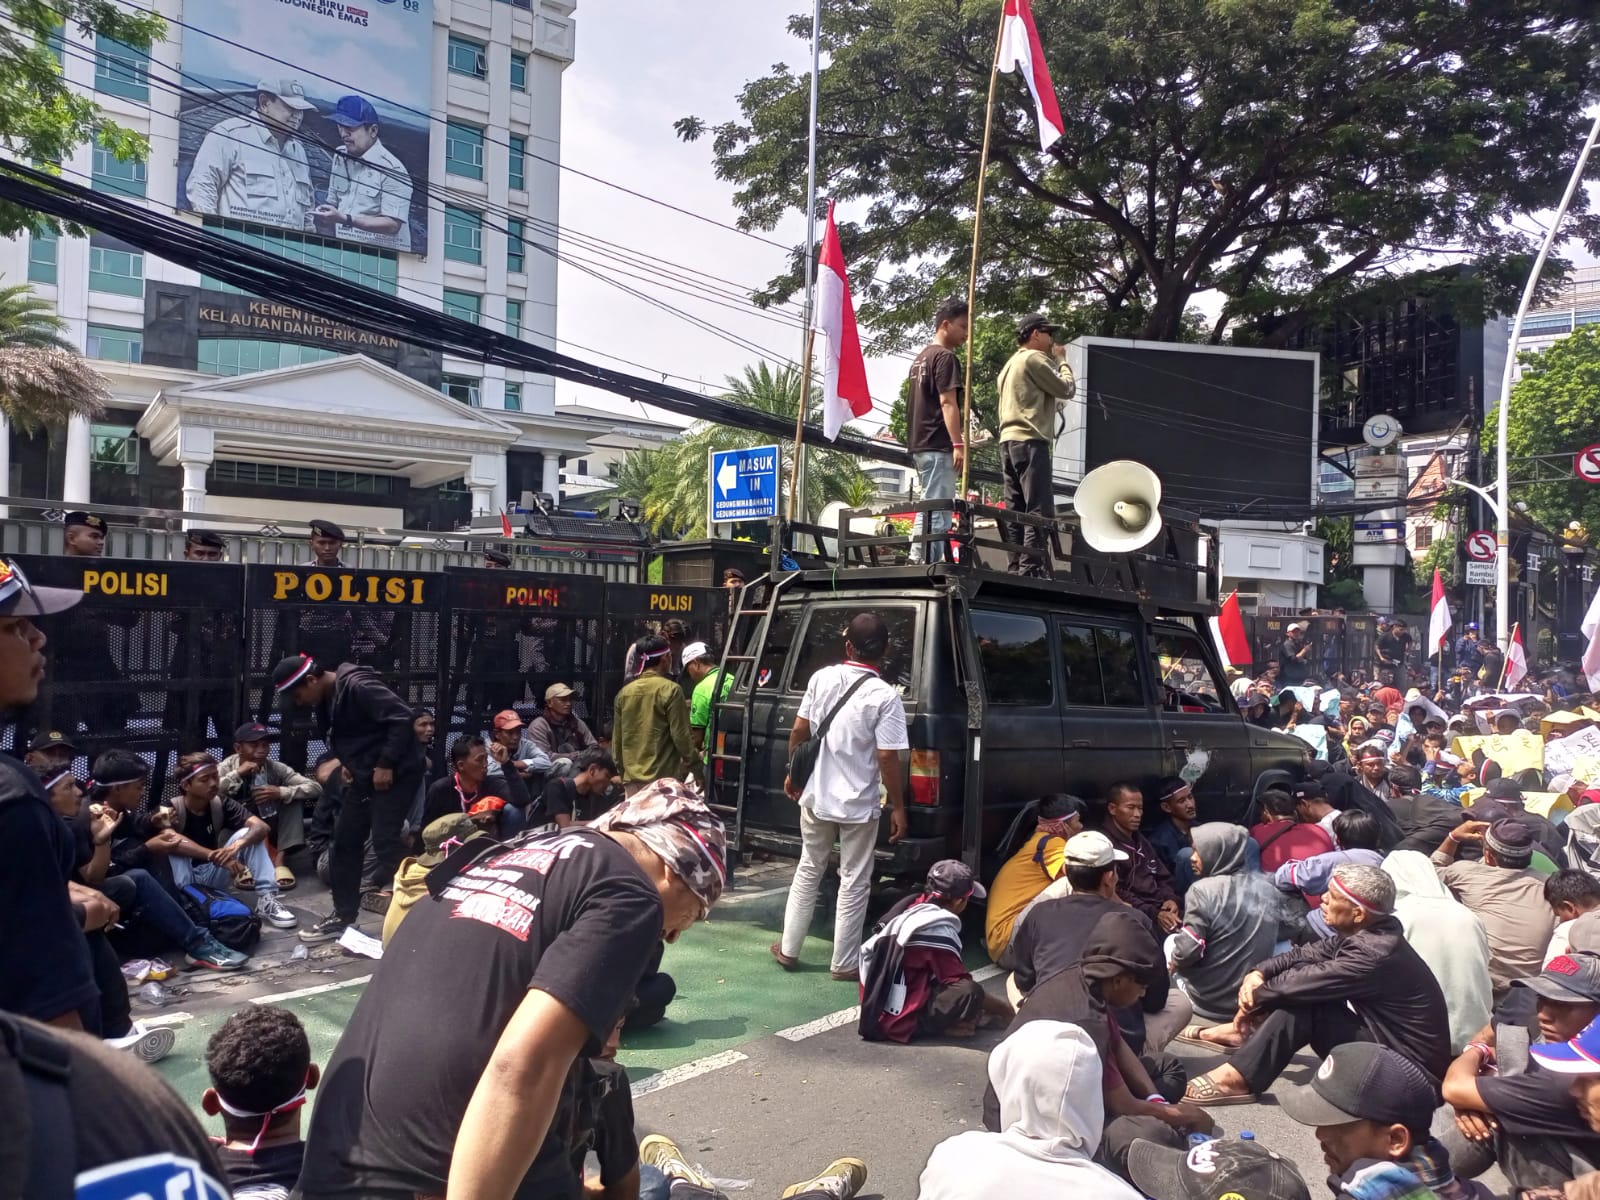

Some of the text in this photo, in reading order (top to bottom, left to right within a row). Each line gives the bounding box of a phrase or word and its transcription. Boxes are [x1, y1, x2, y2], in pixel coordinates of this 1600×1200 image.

[337, 12, 369, 27] EMAS
[249, 301, 356, 329] KEMENTER
[199, 307, 399, 348] KELAUTAN DAN PERIKANAN
[739, 455, 773, 472] MASUK
[750, 477, 760, 491] IN
[83, 571, 167, 596] POLISI
[273, 572, 425, 604] POLISI
[506, 587, 558, 606] POLISI
[650, 594, 692, 611] POLISI
